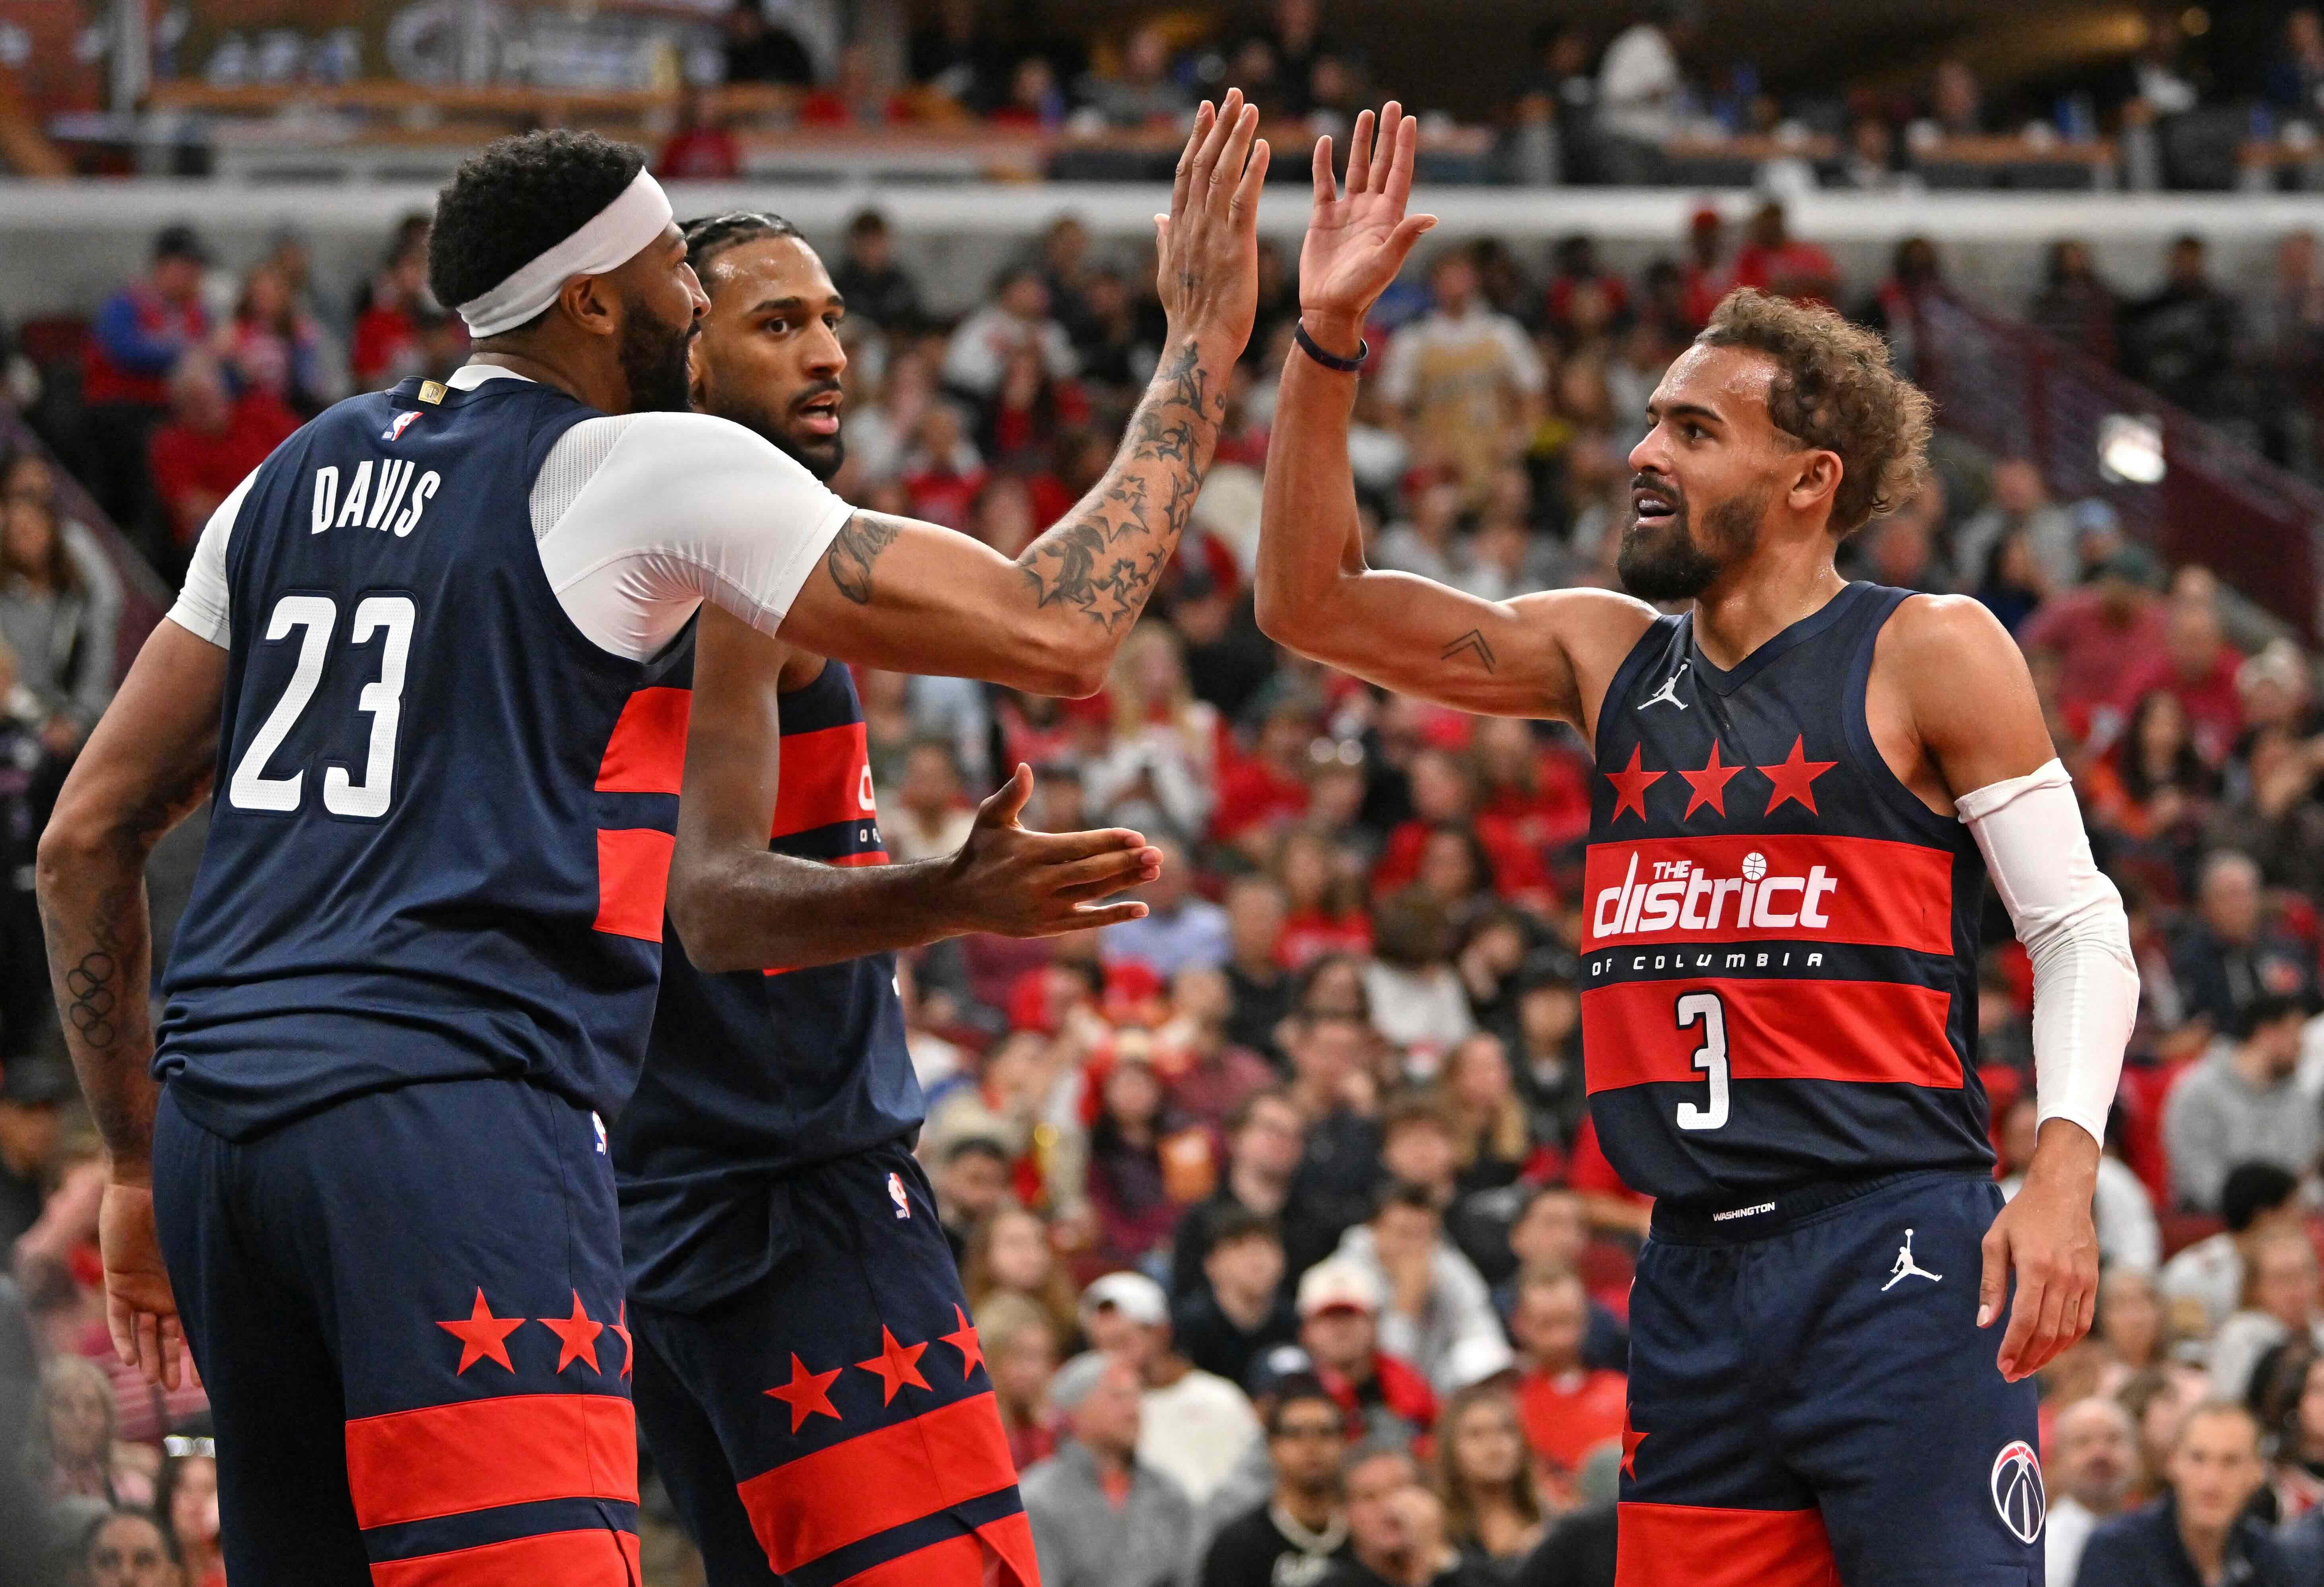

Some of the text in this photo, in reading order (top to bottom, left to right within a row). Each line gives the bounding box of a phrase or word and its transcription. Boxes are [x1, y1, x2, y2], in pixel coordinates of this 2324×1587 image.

[311, 459, 441, 537] DAVIS
[229, 596, 415, 818] 23
[1592, 851, 1838, 938] district
[1653, 860, 1692, 880] THE
[1592, 953, 1823, 976] OF COLUMBIA
[1676, 994, 1729, 1130] 3
[1712, 1202, 1775, 1222] WASHINGTON
